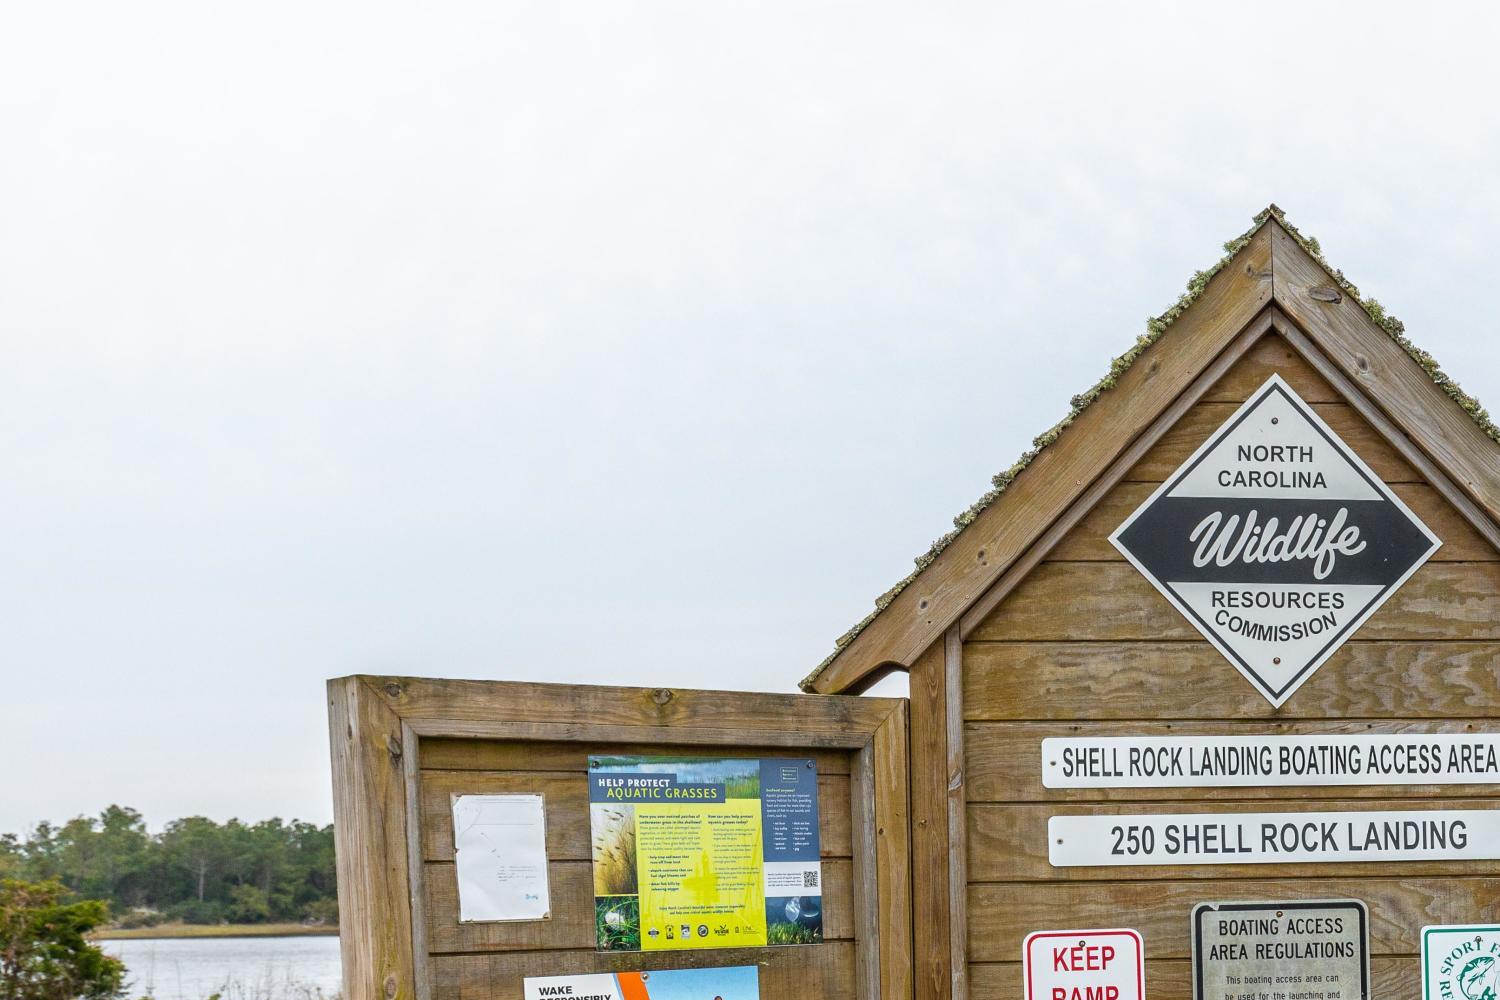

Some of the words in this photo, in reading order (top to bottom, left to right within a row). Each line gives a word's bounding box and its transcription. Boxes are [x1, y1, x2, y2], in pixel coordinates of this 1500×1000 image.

[1237, 445, 1313, 463] NORTH
[1218, 470, 1327, 489] CAROLINA
[1189, 508, 1366, 580] Wildlife
[1211, 591, 1345, 609] RESOURCES
[1214, 609, 1338, 642] COMMISSION
[1063, 747, 1124, 777] SHELL
[1129, 747, 1183, 777] ROCK
[1189, 746, 1273, 776] LANDING
[1279, 745, 1361, 775] BOATING
[1367, 745, 1442, 774] ACCESS
[1447, 744, 1498, 773] AREA
[599, 779, 624, 787] HELP
[628, 779, 670, 787] PROTECT
[607, 788, 660, 800] AQUATIC
[665, 788, 719, 798] GRASSES
[1111, 825, 1155, 855] 250
[1164, 824, 1252, 854] SHELL
[1261, 822, 1339, 853] ROCK
[1347, 820, 1468, 851] LANDING
[1219, 919, 1279, 936] BOATING
[1287, 918, 1343, 934] ACCESS
[1053, 946, 1115, 972] KEEP
[1210, 944, 1247, 960] AREA
[1256, 942, 1354, 959] REGULATIONS
[1440, 940, 1481, 976] SPORT
[1226, 975, 1241, 984] This
[1244, 975, 1272, 986] boating
[1306, 975, 1322, 983] area
[539, 986, 572, 995] WAKE
[1225, 993, 1234, 1000] be
[1238, 993, 1255, 1000] used
[1259, 992, 1269, 1000] for
[1273, 992, 1285, 1000] the
[1327, 991, 1340, 999] and
